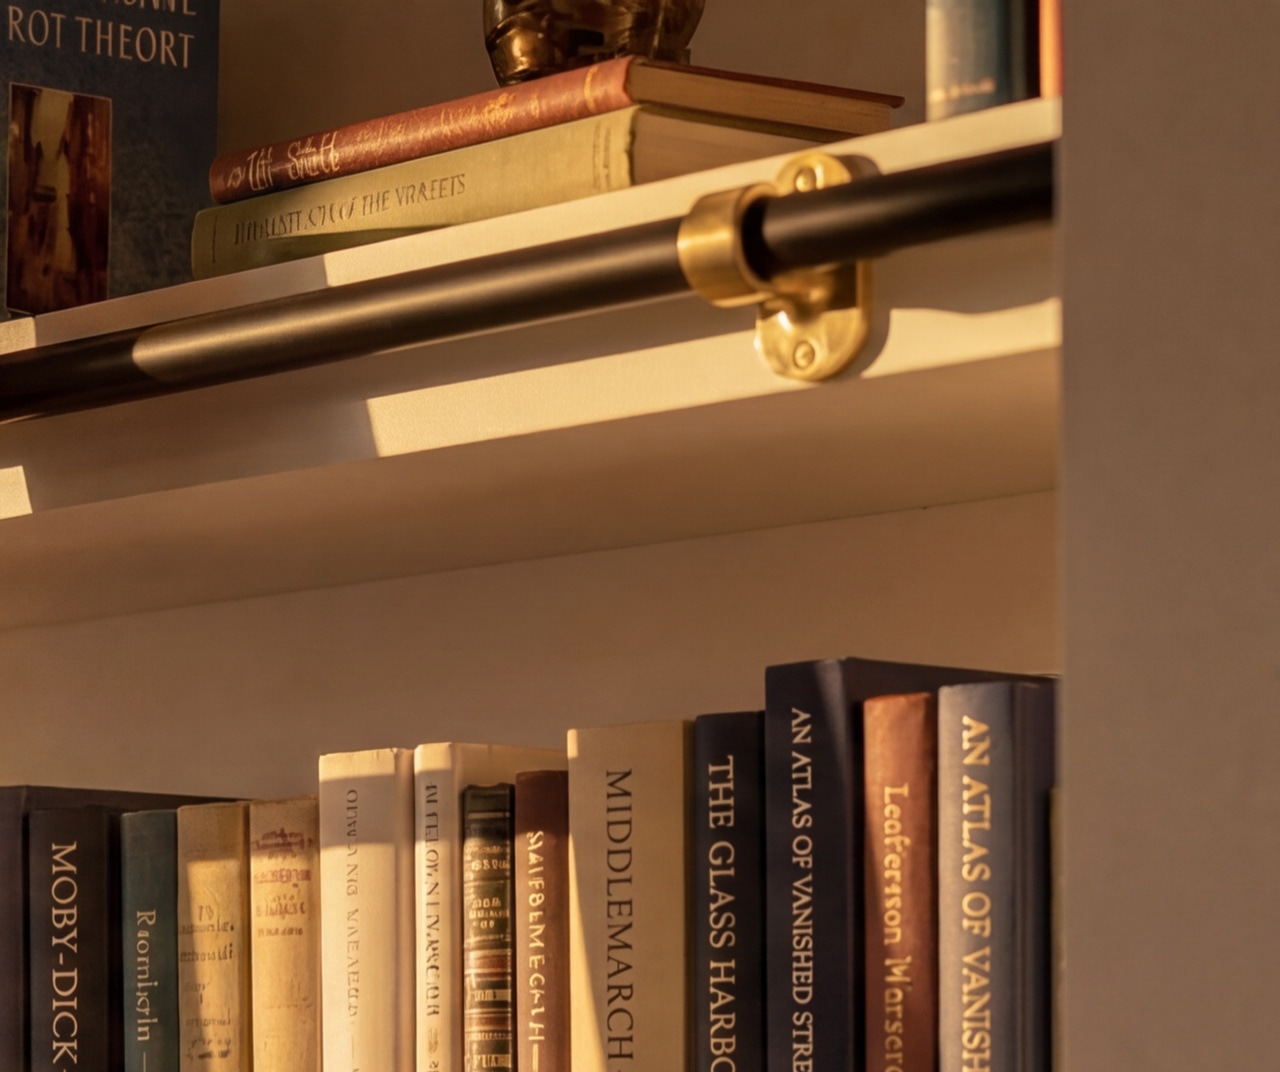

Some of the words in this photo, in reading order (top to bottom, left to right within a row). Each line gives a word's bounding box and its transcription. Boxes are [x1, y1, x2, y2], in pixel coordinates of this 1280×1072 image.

[7, 5, 67, 49] ROT
[791, 707, 812, 744] AN
[961, 716, 990, 766] AN
[708, 754, 735, 829] THE
[791, 750, 812, 829] ATLAS
[791, 834, 812, 869] OF
[961, 775, 991, 883] ATLAS
[606, 768, 634, 1061] MIDDLEMARCH
[708, 840, 735, 949] GLASS
[961, 891, 992, 937] OF
[50, 841, 78, 1065] MOBY-DICK
[791, 873, 812, 1004] VANISHED
